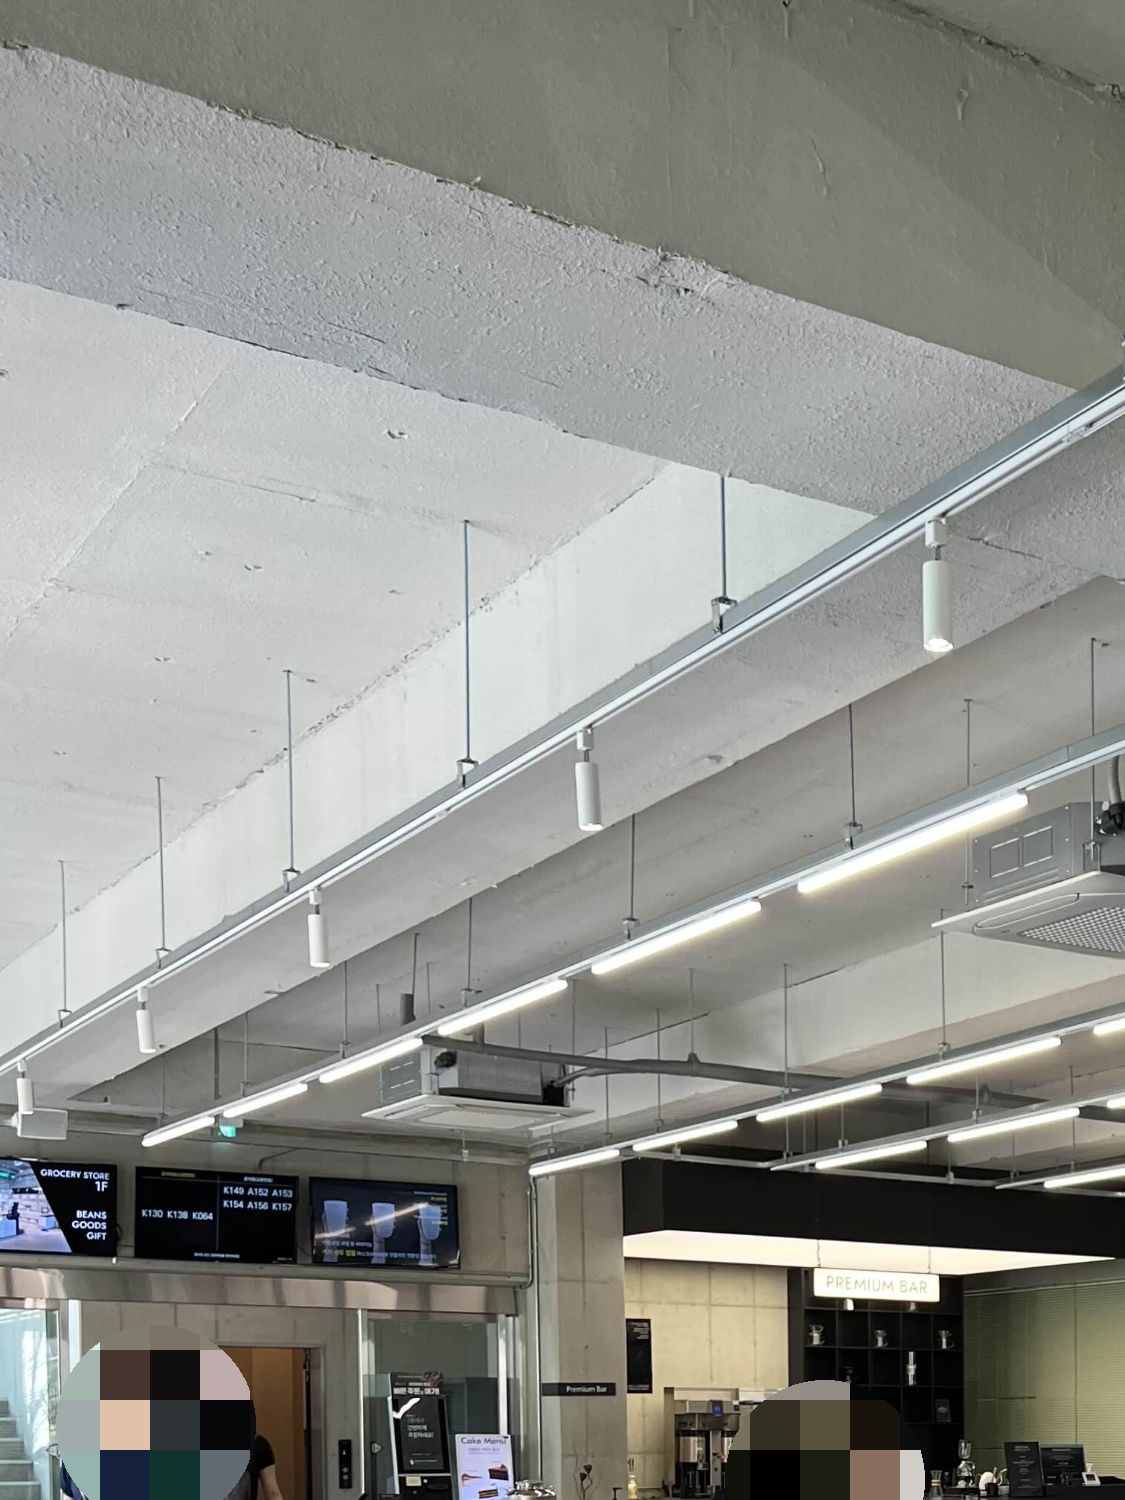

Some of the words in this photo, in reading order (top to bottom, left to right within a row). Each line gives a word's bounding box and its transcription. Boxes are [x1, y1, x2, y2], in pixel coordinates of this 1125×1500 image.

[40, 1168, 81, 1179] GROCERY
[83, 1171, 110, 1181] STORE
[95, 1181, 108, 1192] 1F
[247, 1187, 269, 1197] A152
[223, 1200, 244, 1209] K154
[272, 1202, 292, 1211] K157
[76, 1210, 107, 1220] BEANS
[141, 1209, 163, 1218] K130
[71, 1220, 107, 1230] GOODS
[86, 1231, 107, 1240] GIFT
[826, 1275, 895, 1292] PREMIUM
[899, 1279, 928, 1294] BAR
[566, 1385, 596, 1393] Premium
[596, 1385, 607, 1393] Bar
[460, 1436, 482, 1445] Cake
